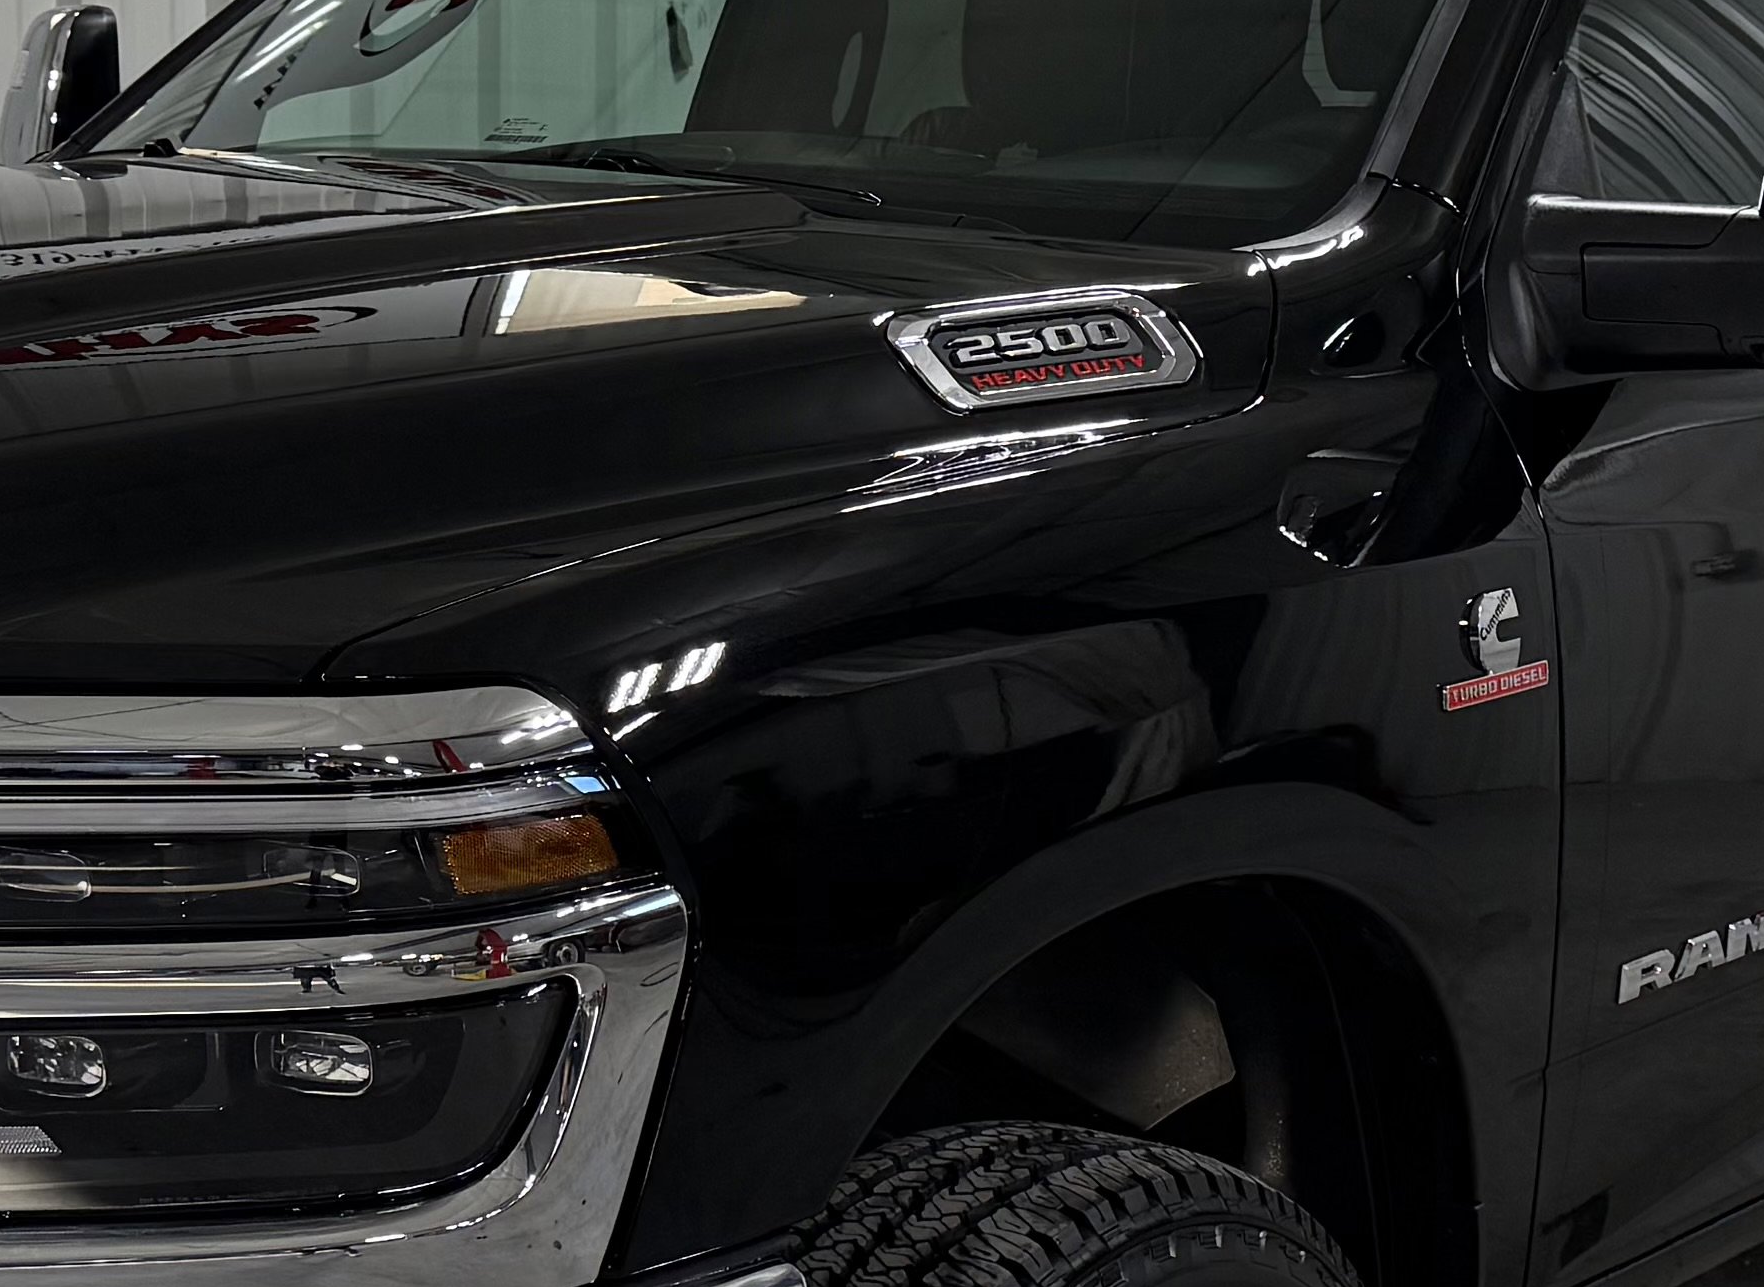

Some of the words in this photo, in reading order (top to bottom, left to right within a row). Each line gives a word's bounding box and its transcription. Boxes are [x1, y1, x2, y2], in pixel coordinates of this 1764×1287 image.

[947, 317, 1132, 364] 2500
[971, 363, 1067, 391] HEAVY
[1070, 354, 1146, 378] DUTY
[1452, 679, 1499, 703] TURBO
[1500, 666, 1547, 691] DIESEL
